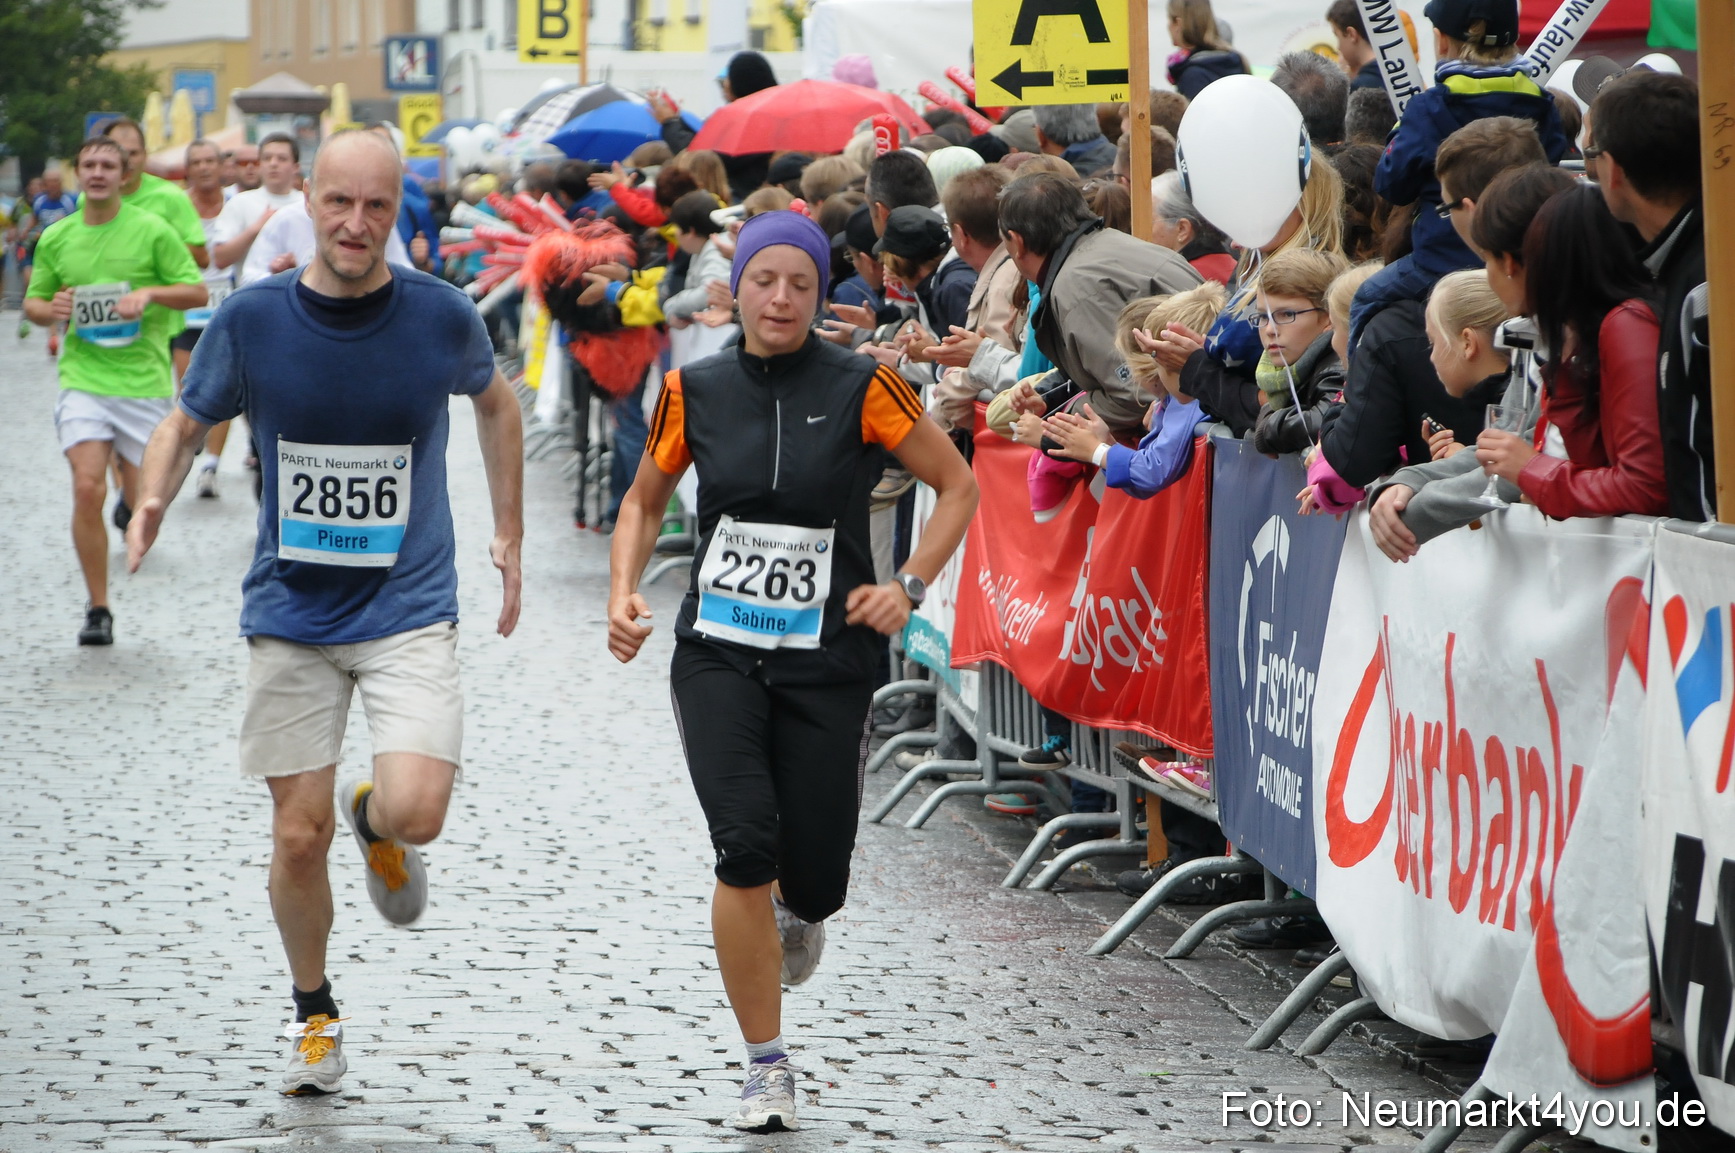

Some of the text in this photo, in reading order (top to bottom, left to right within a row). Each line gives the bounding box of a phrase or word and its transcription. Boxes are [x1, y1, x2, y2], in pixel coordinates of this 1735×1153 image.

[538, 0, 570, 39] B
[281, 452, 388, 470] PARTL Neumarkt
[291, 472, 398, 520] 2856
[317, 528, 369, 550] Pierre
[752, 537, 811, 552] Neumarkt
[711, 549, 817, 603] 2263
[731, 605, 787, 632] Sabine
[1254, 619, 1315, 749] Fischer
